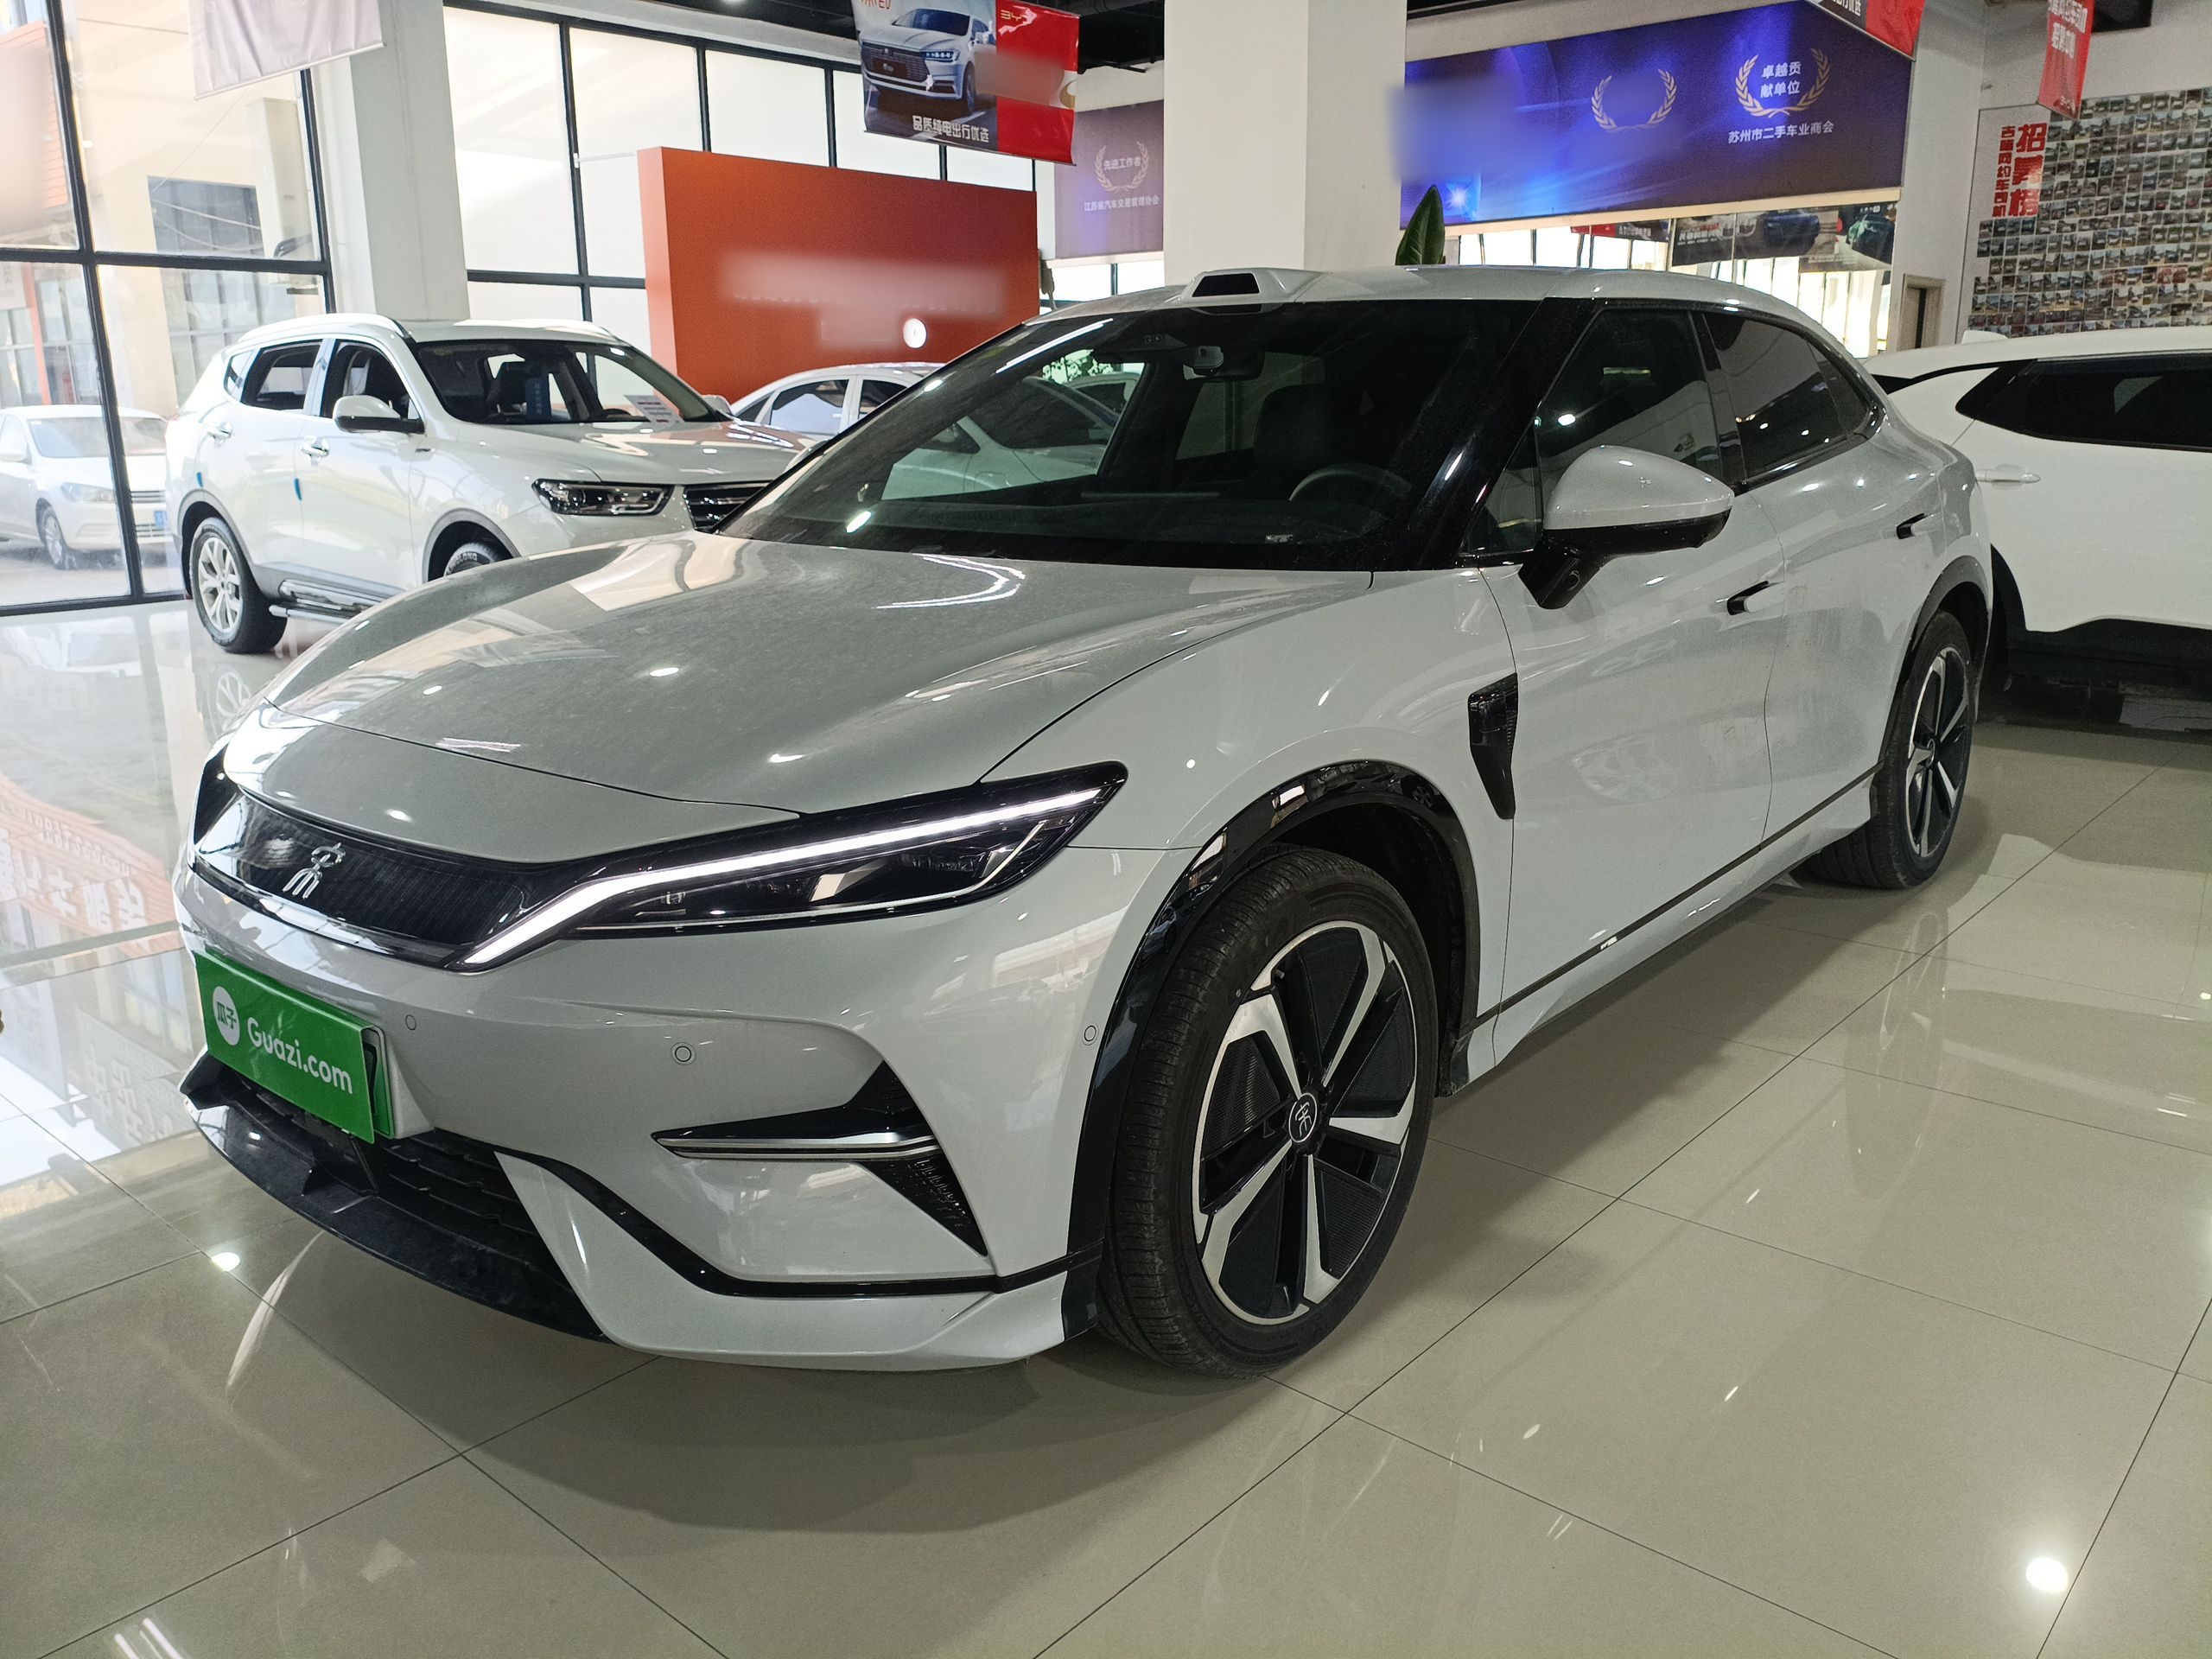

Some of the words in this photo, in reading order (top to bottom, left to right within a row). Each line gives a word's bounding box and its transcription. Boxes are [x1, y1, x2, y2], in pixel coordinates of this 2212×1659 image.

[1762, 60, 1802, 79] 卓越贡
[1760, 80, 1801, 98] 献单位
[912, 115, 989, 143] 品质纯电出行优选
[1728, 120, 1834, 143] 苏州市二手车业商会
[1103, 156, 1141, 171] 先进工作者
[216, 1001, 238, 1030] 瓜子
[247, 1017, 353, 1095] Guazi.com
